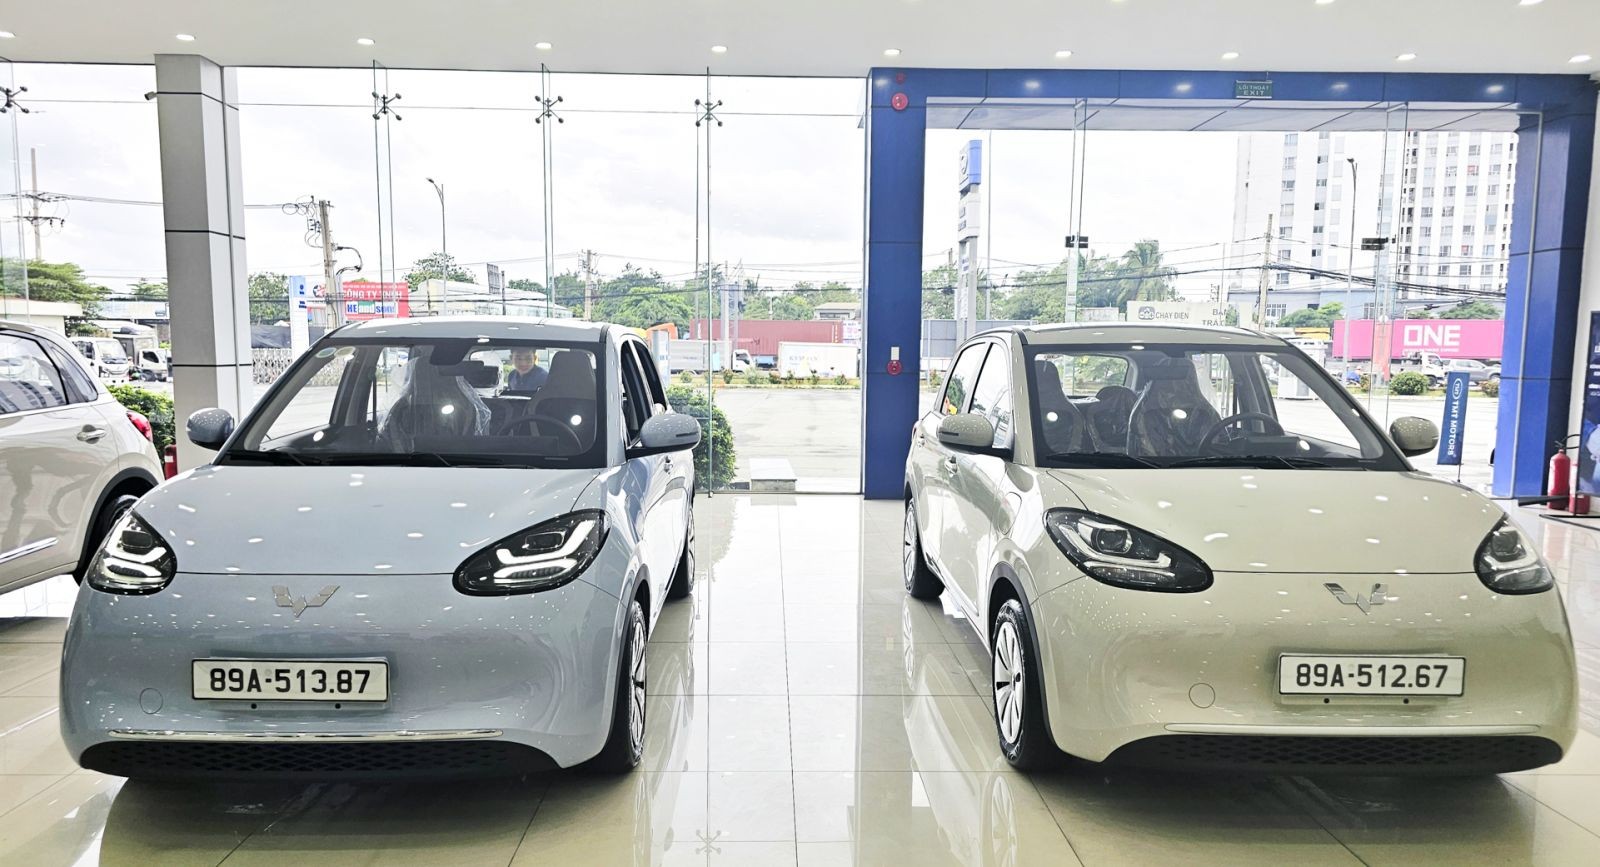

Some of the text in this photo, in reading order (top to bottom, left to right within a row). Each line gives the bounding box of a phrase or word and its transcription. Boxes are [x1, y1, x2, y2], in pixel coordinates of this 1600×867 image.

[366, 290, 377, 299] TY
[1403, 324, 1461, 346] ONE
[1448, 400, 1459, 456] TMT MOTORS
[209, 668, 371, 694] 89A-513.87
[1296, 663, 1448, 688] 89A-512.67
